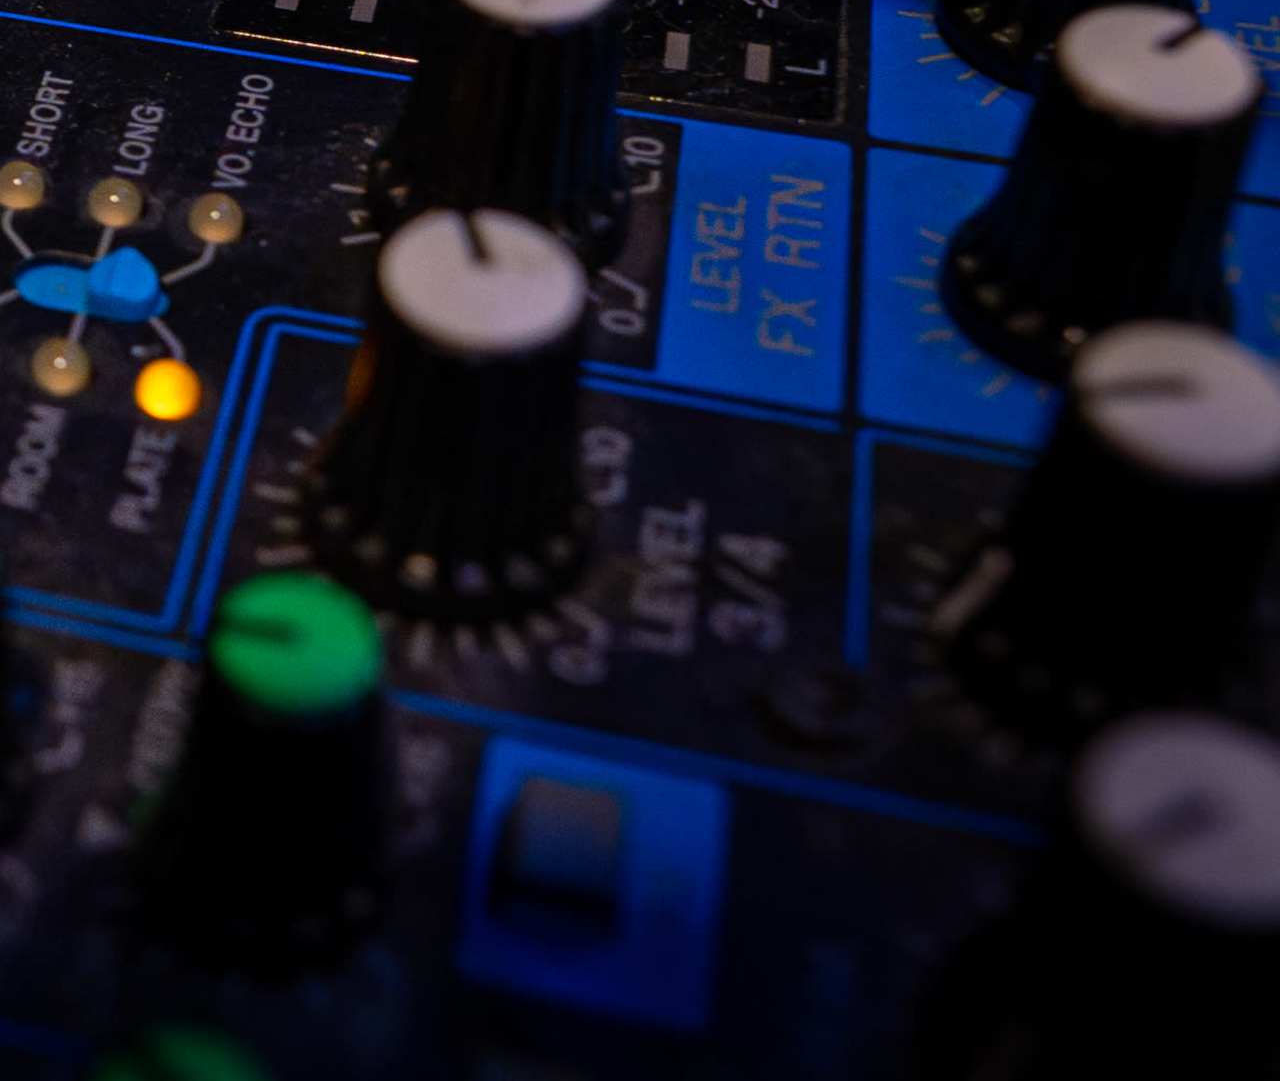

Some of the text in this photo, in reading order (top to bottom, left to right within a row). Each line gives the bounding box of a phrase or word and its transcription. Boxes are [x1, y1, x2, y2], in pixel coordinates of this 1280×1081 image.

[784, 57, 829, 79] L
[18, 70, 75, 160] SHORT
[113, 102, 166, 177] LONG
[622, 135, 665, 166] 10
[689, 194, 748, 314] LEVEL
[756, 172, 827, 357] FX RTN
[597, 306, 646, 336] 0
[109, 425, 178, 534] PLATE
[628, 497, 708, 658] LEVEL
